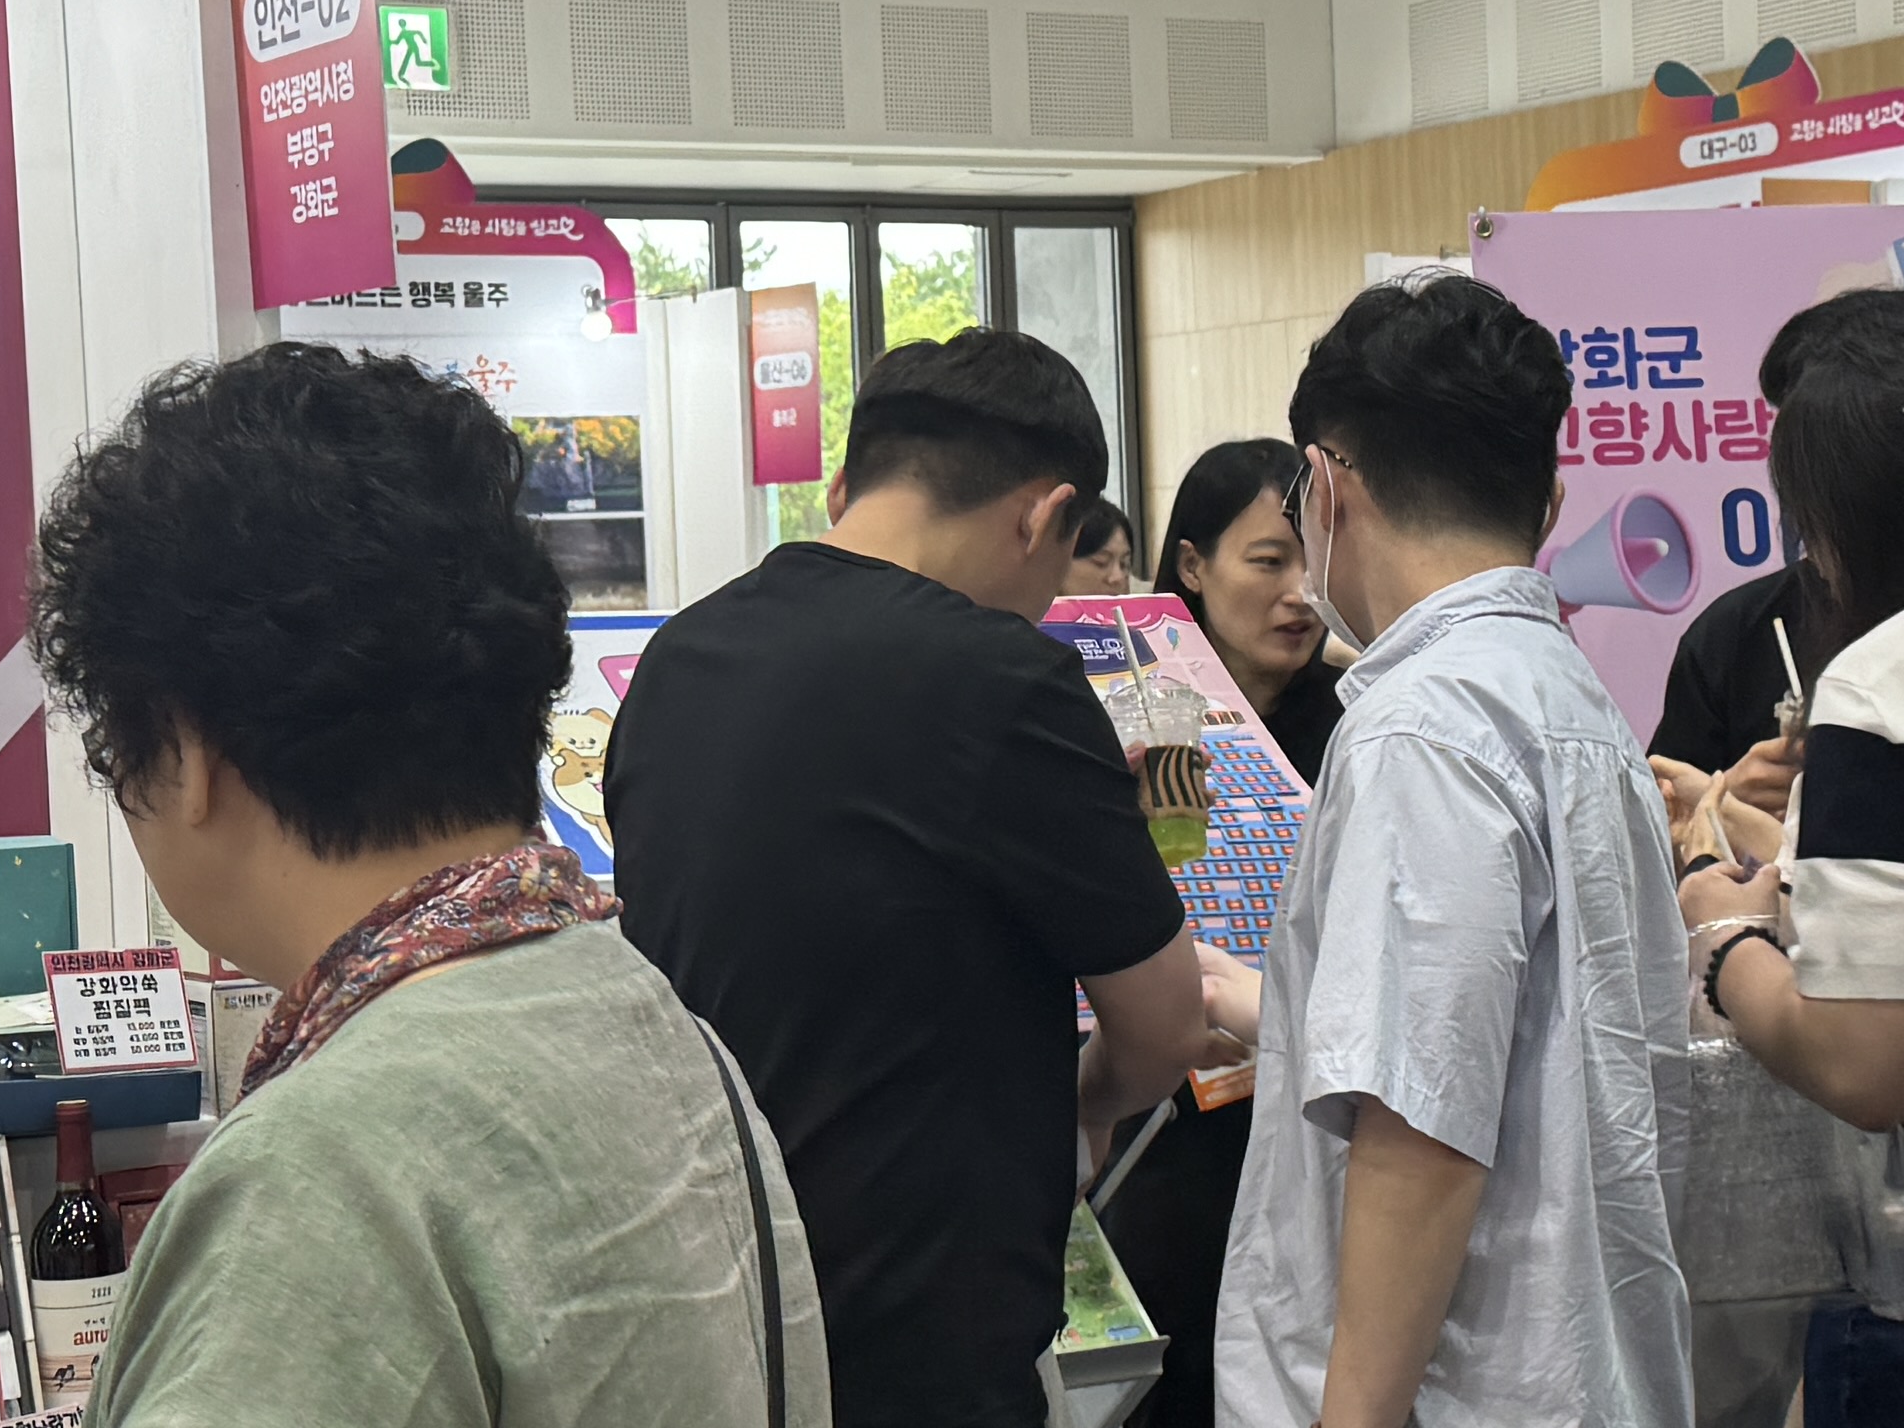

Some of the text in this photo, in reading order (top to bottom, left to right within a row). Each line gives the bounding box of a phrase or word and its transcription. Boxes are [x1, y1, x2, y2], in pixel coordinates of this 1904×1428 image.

[260, 59, 355, 123] 인천광역시청
[286, 123, 335, 168] 부평구
[1701, 132, 1757, 159] 대구-03
[290, 177, 338, 224] 강화군
[409, 281, 455, 308] 행복
[463, 281, 509, 308] 울주
[1558, 327, 1704, 391] 화군
[50, 951, 124, 972] 인천광역시
[77, 974, 158, 997] 강화약쑥
[93, 998, 151, 1019] 찜질팩
